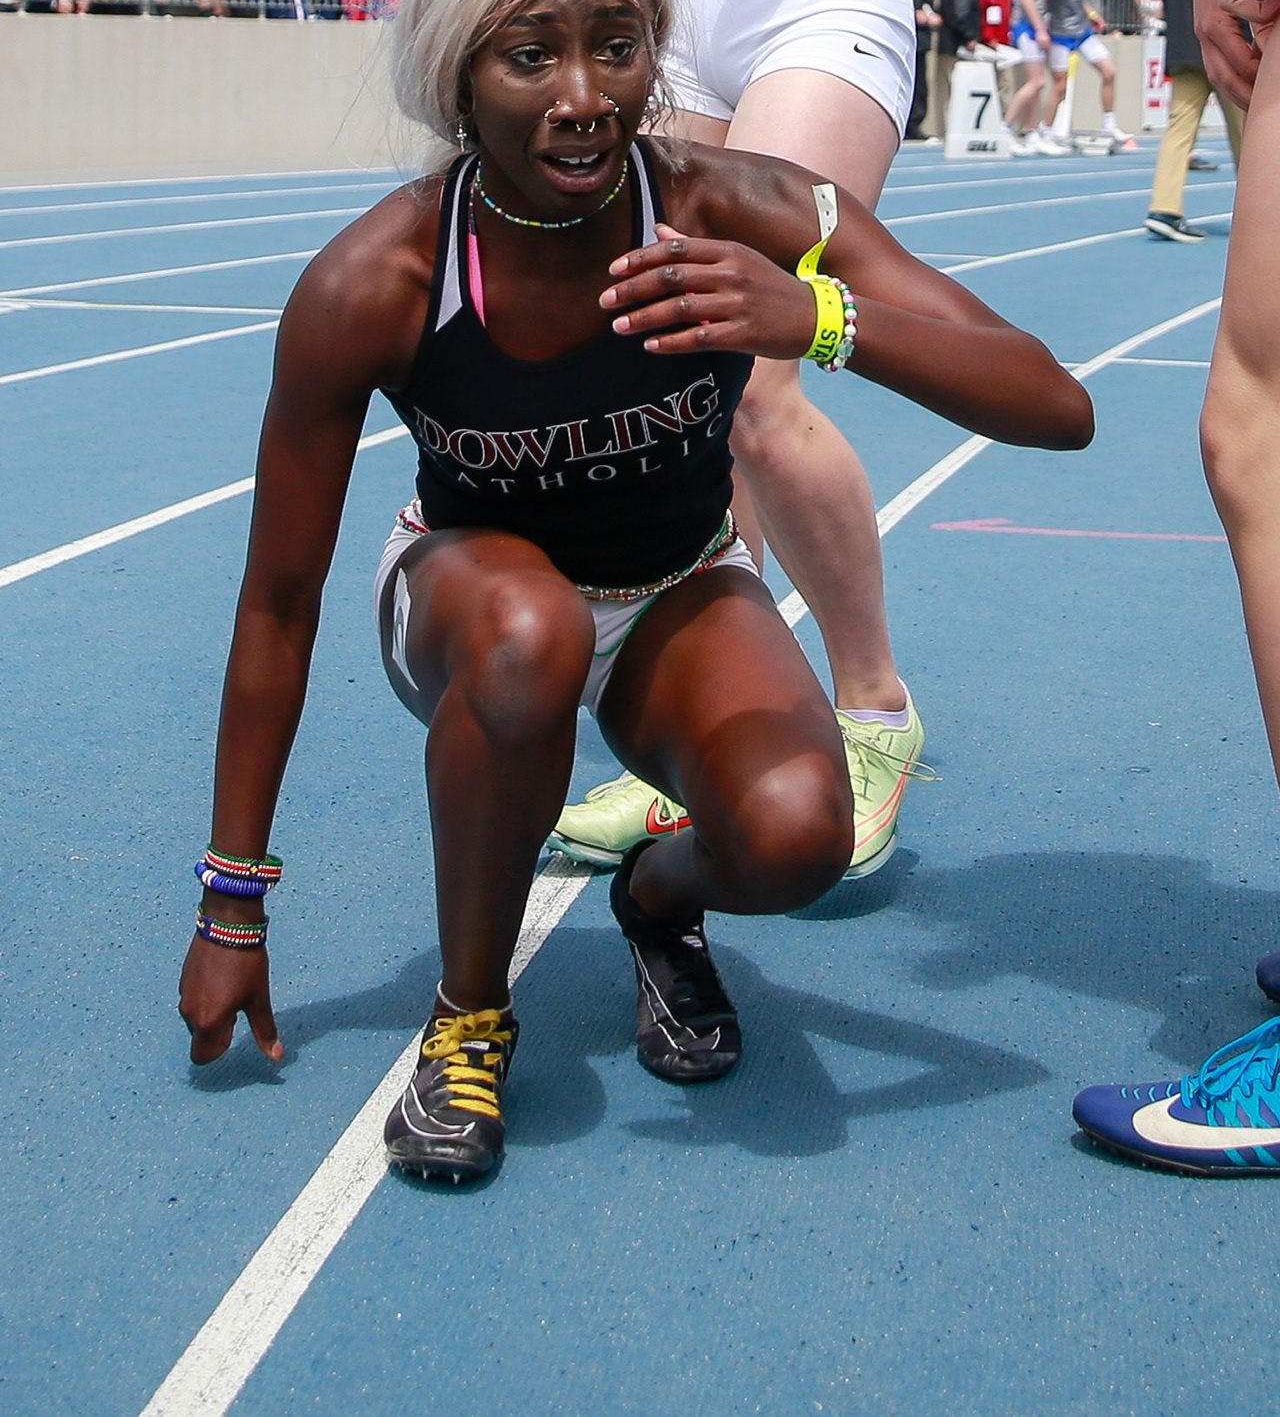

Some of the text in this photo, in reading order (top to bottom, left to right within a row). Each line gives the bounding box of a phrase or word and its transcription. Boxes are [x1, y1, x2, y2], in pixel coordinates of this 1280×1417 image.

[969, 91, 992, 130] 7
[413, 372, 720, 471] DOWLING
[423, 412, 723, 494] ATHOLIC
